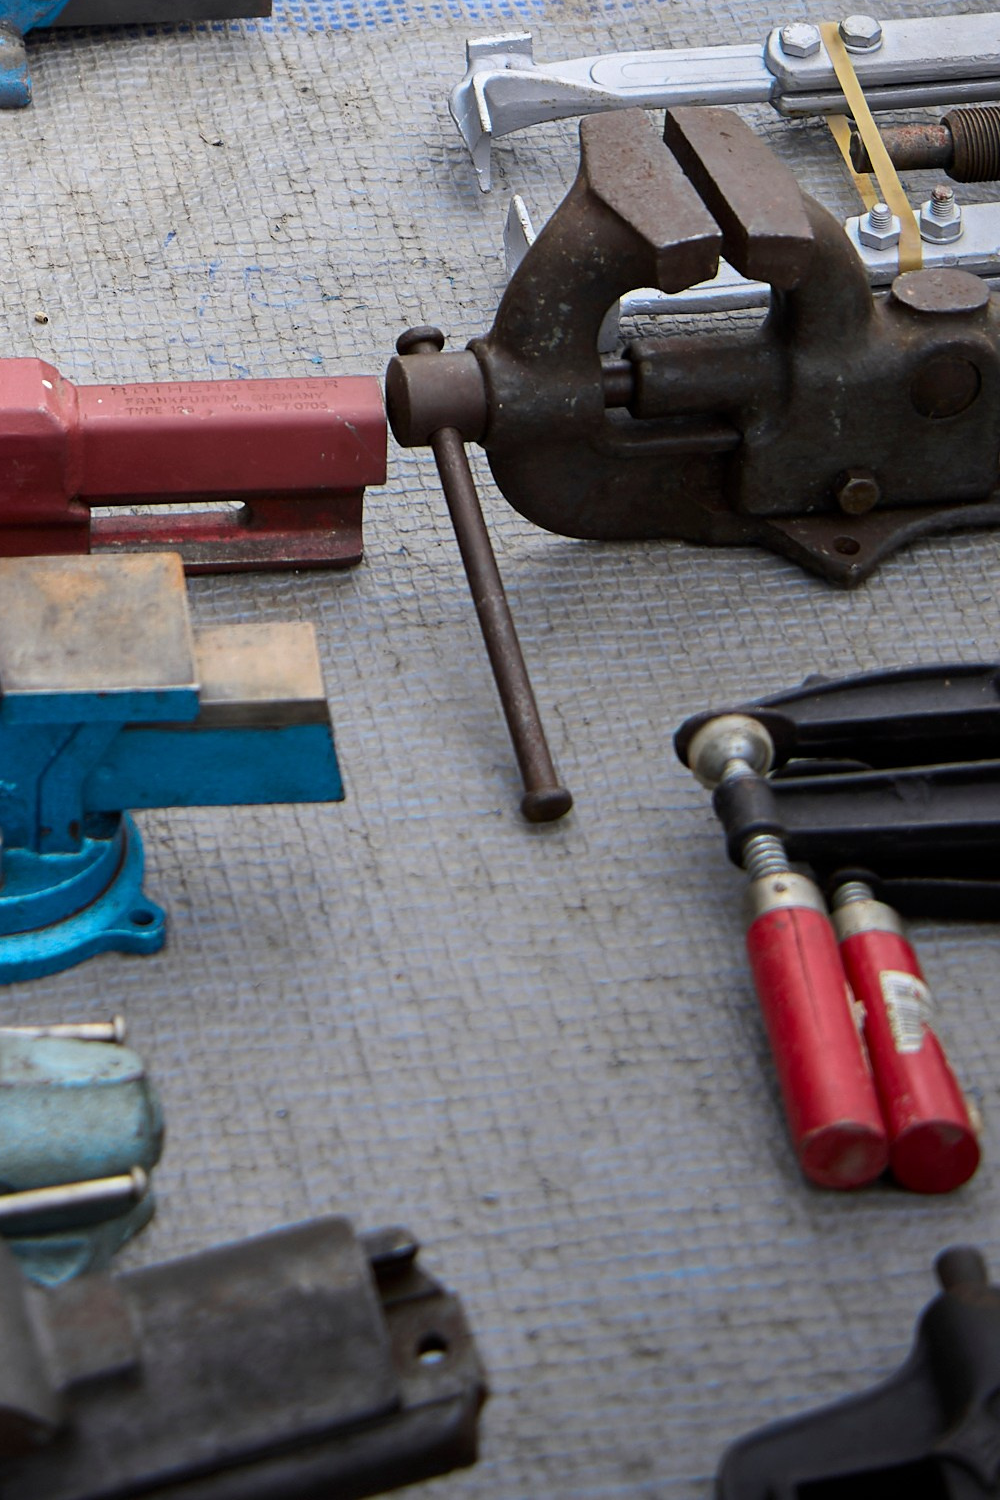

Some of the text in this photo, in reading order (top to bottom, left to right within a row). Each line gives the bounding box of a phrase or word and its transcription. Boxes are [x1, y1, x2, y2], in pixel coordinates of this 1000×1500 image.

[111, 379, 339, 396] ROTHENBERGER
[251, 391, 323, 402] GERMANY
[124, 405, 162, 416] TYPE
